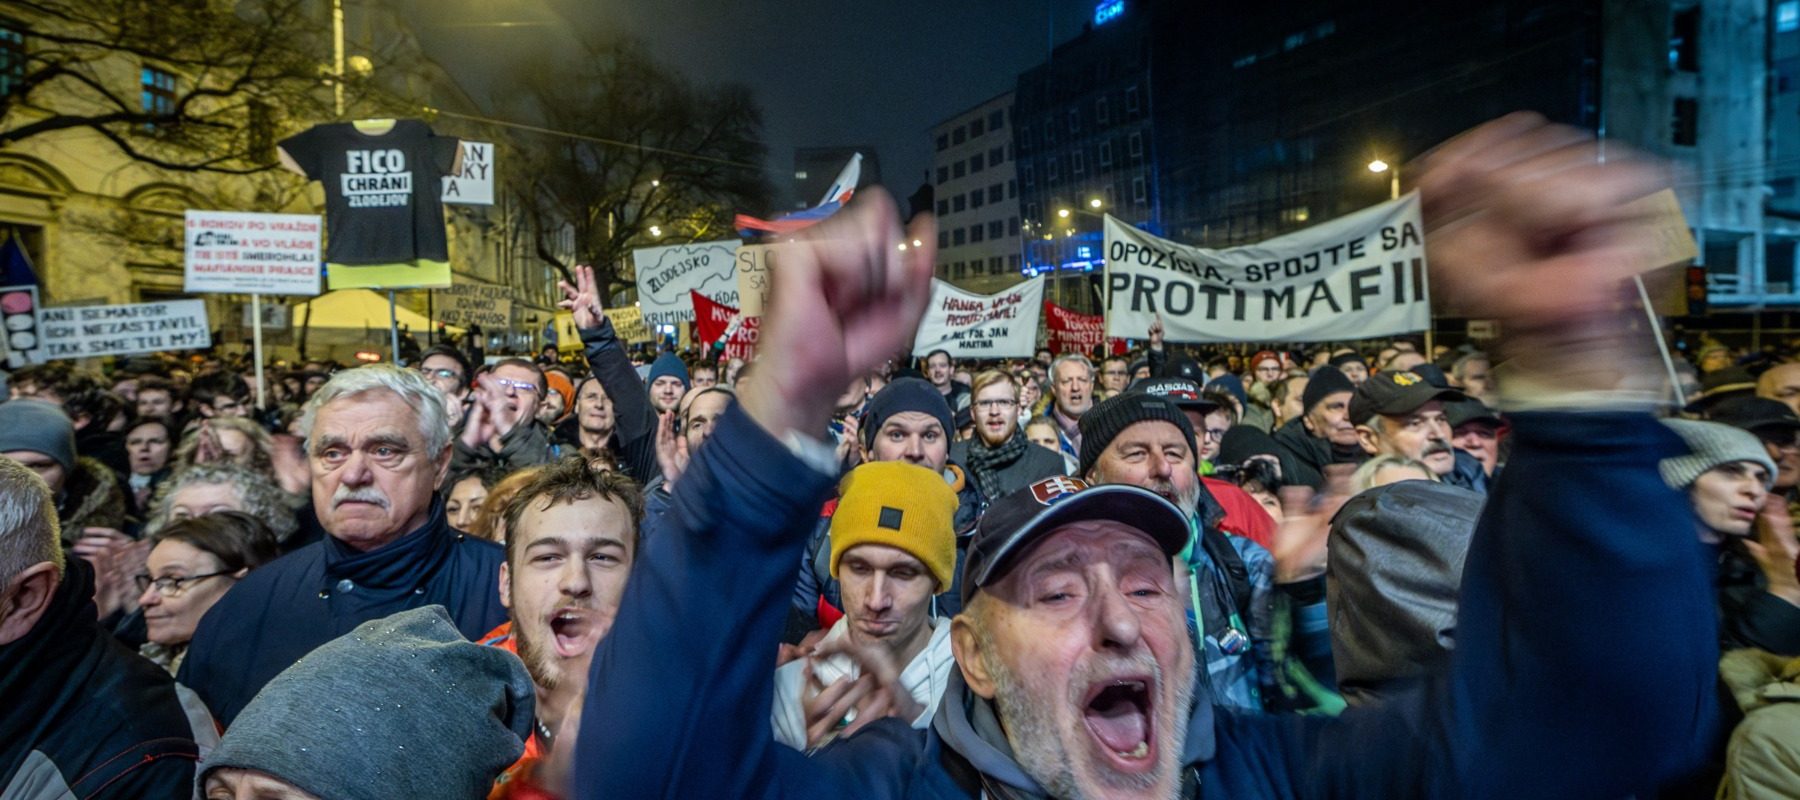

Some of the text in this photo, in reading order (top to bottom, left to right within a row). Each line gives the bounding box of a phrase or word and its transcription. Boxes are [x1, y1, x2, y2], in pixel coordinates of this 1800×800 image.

[346, 150, 406, 174] FICO
[347, 173, 409, 191] CHRÁNI
[348, 194, 409, 208] ZLODEJOV
[247, 220, 266, 231] PO
[269, 220, 318, 232] VRAŽDE
[252, 239, 272, 248] VO
[739, 250, 776, 273] SLO
[1110, 221, 1420, 286] OPOZÍCIA, SPOJTE SA
[646, 253, 711, 294] ZLODEJSKO
[1108, 257, 1425, 321] PROTI MAFII
[81, 304, 168, 321] SEMAFOR
[943, 296, 985, 312] HANBA
[83, 316, 200, 336] NEZASTAVIL
[643, 308, 696, 326] KRIMINA
[47, 328, 206, 356] TAK SME TU MY!
[969, 328, 985, 339] FOR
[988, 327, 1008, 338] JAN
[958, 340, 994, 350] MARTINA
